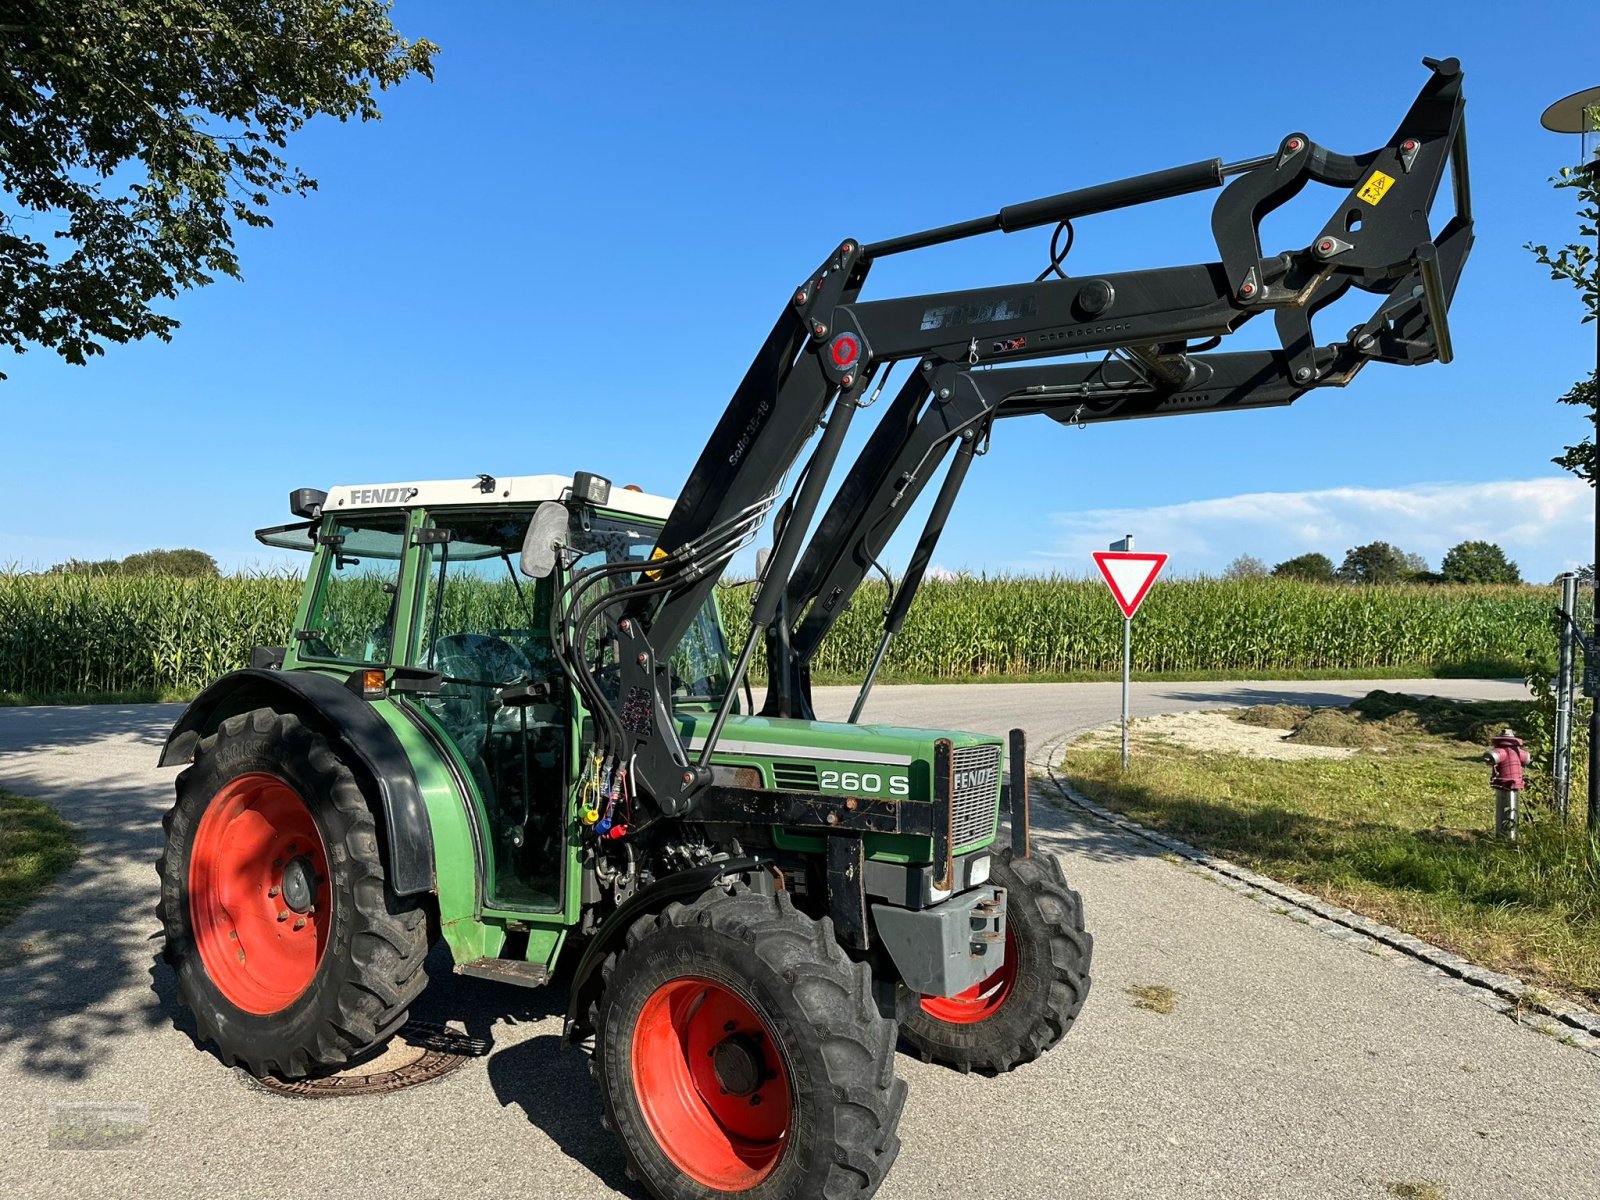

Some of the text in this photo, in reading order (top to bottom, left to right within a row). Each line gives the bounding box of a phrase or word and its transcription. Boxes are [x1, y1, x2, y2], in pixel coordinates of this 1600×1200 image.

[729, 401, 769, 466] Solid 35-18
[350, 487, 412, 505] FENDT
[820, 769, 910, 796] 260 S
[954, 767, 994, 790] FENDT
